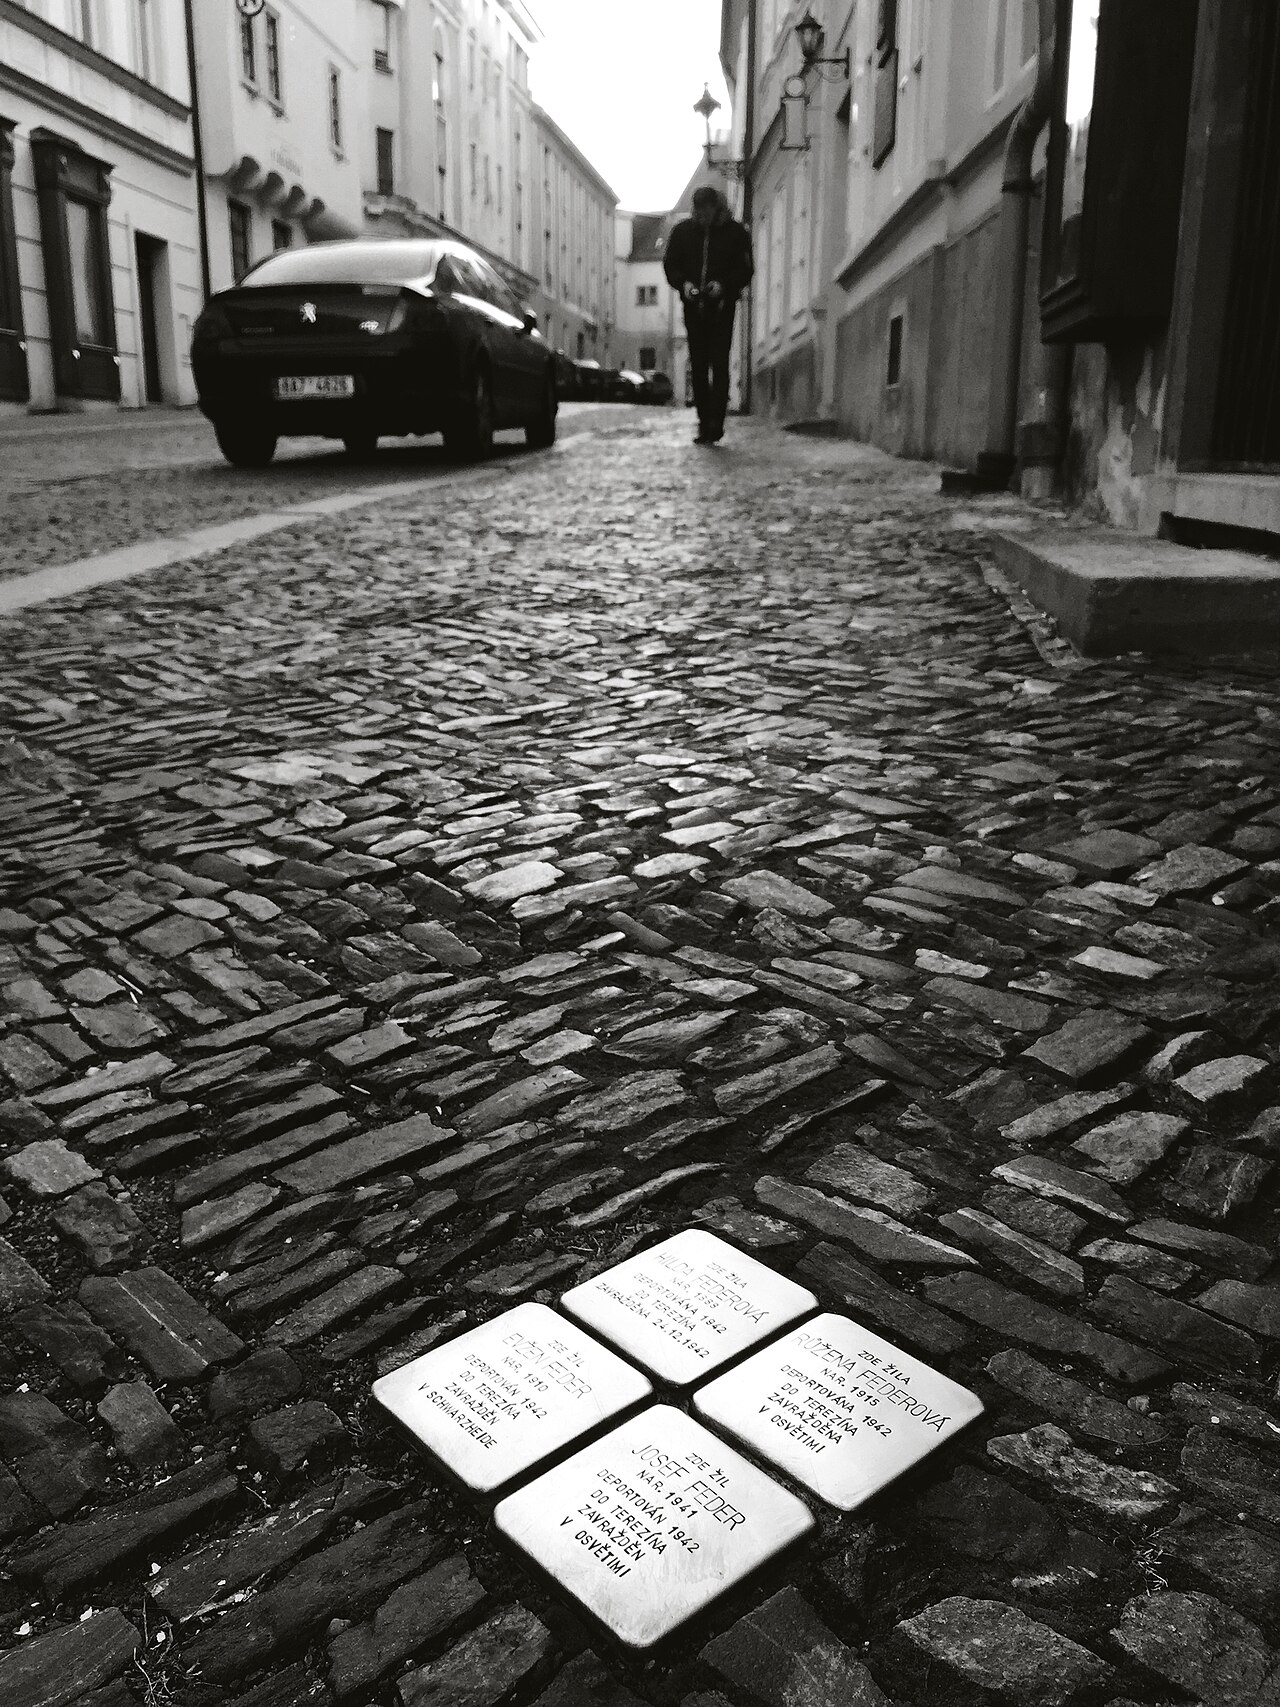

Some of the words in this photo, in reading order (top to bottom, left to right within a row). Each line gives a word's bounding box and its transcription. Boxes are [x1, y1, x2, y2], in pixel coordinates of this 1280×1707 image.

[656, 1252, 695, 1277] HILDA
[693, 1275, 770, 1324] FEDEROVÁ
[671, 1277, 690, 1293] NAR.
[707, 1262, 725, 1276] ZDE
[725, 1272, 748, 1289] ŽILA
[596, 1283, 651, 1319] ZAVRAŽDĚNA
[653, 1318, 710, 1358] 24.12.1942
[633, 1273, 698, 1315] DEPORTOVÁNA
[700, 1313, 727, 1334] 1942
[635, 1289, 649, 1299] DO
[652, 1299, 697, 1331] TEREZÍNA
[501, 1356, 521, 1374] NAR.
[525, 1373, 548, 1392] 1910
[502, 1333, 548, 1366] EVŽEN
[542, 1361, 592, 1399] FEDER
[548, 1340, 569, 1354] ZDE
[566, 1351, 586, 1368] ŽIL
[857, 1350, 881, 1366] ZDE
[882, 1362, 911, 1385] ŽILA
[445, 1382, 500, 1426] ZAVRAŽDĚN
[459, 1370, 474, 1382] DO
[476, 1383, 520, 1420] TEREZÍNA
[465, 1354, 521, 1397] DEPORTOVÁN
[522, 1398, 548, 1419] 1942
[780, 1364, 856, 1413] DEPORTOVÁNA
[862, 1415, 893, 1438] 1942
[780, 1382, 798, 1396] DO
[803, 1396, 858, 1436] TEREZÍNA
[792, 1333, 856, 1372] RŮŽENA
[856, 1370, 951, 1432] FEDEROVÁ
[820, 1368, 846, 1387] NAR.
[851, 1386, 880, 1407] 1915
[418, 1382, 429, 1392] V
[427, 1391, 498, 1449] SCHWARZHEIDE
[759, 1405, 770, 1414] V
[771, 1414, 826, 1453] OSVĚTIMI
[768, 1392, 842, 1444] ZAVRAŽDĚNA
[632, 1445, 689, 1478] JOSEF
[685, 1480, 746, 1531] FEDER
[637, 1470, 662, 1493] NAR.
[665, 1493, 698, 1519] 1941
[685, 1453, 709, 1471] ZDE
[711, 1467, 730, 1488] ŽIL
[578, 1504, 646, 1561] ZAVRAŽDĚN
[590, 1489, 609, 1504] DO
[610, 1505, 668, 1555] TEREZÍNA
[597, 1469, 667, 1524] DEPORTOVÁN
[669, 1527, 700, 1554] 1942
[560, 1516, 574, 1527] V
[575, 1530, 631, 1577] OSVĚTIMI
